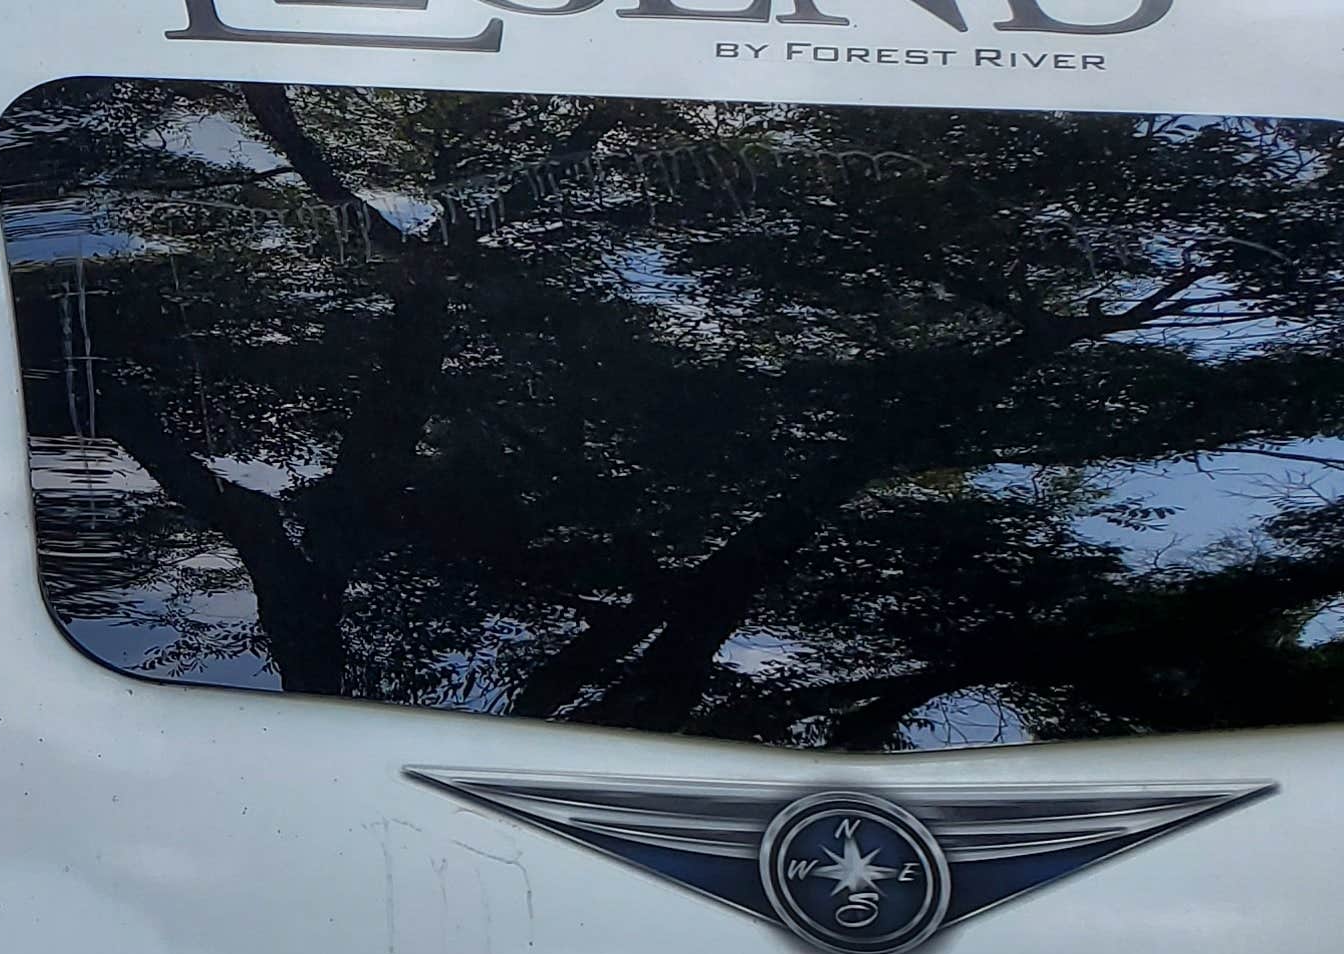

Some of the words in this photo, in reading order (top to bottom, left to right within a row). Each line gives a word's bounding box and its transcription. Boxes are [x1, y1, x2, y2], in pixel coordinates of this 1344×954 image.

[834, 818, 861, 839] N
[787, 859, 819, 881] W
[898, 862, 919, 882] E
[835, 892, 880, 928] S
